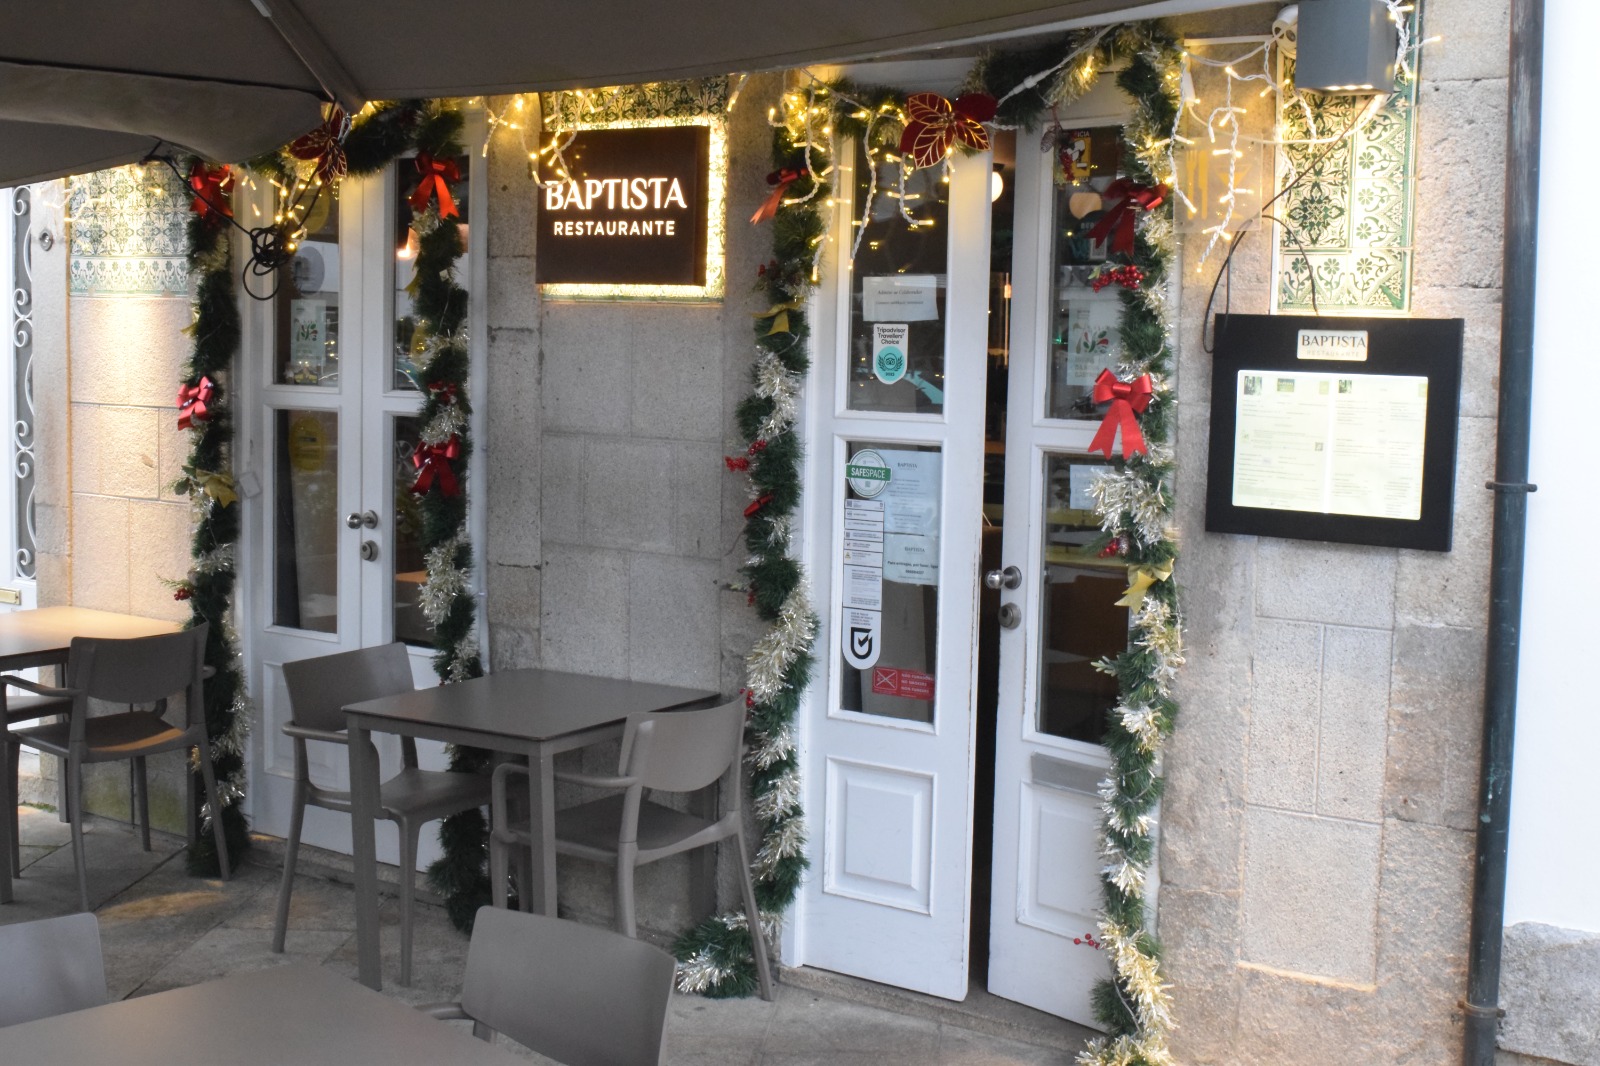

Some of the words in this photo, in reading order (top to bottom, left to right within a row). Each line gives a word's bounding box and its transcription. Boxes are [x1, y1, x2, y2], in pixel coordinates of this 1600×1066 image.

[545, 177, 687, 210] BAPTISTA
[554, 220, 675, 235] RESTAURANTE
[1301, 334, 1366, 348] BAPTISTA
[851, 467, 886, 479] SAFESPACE
